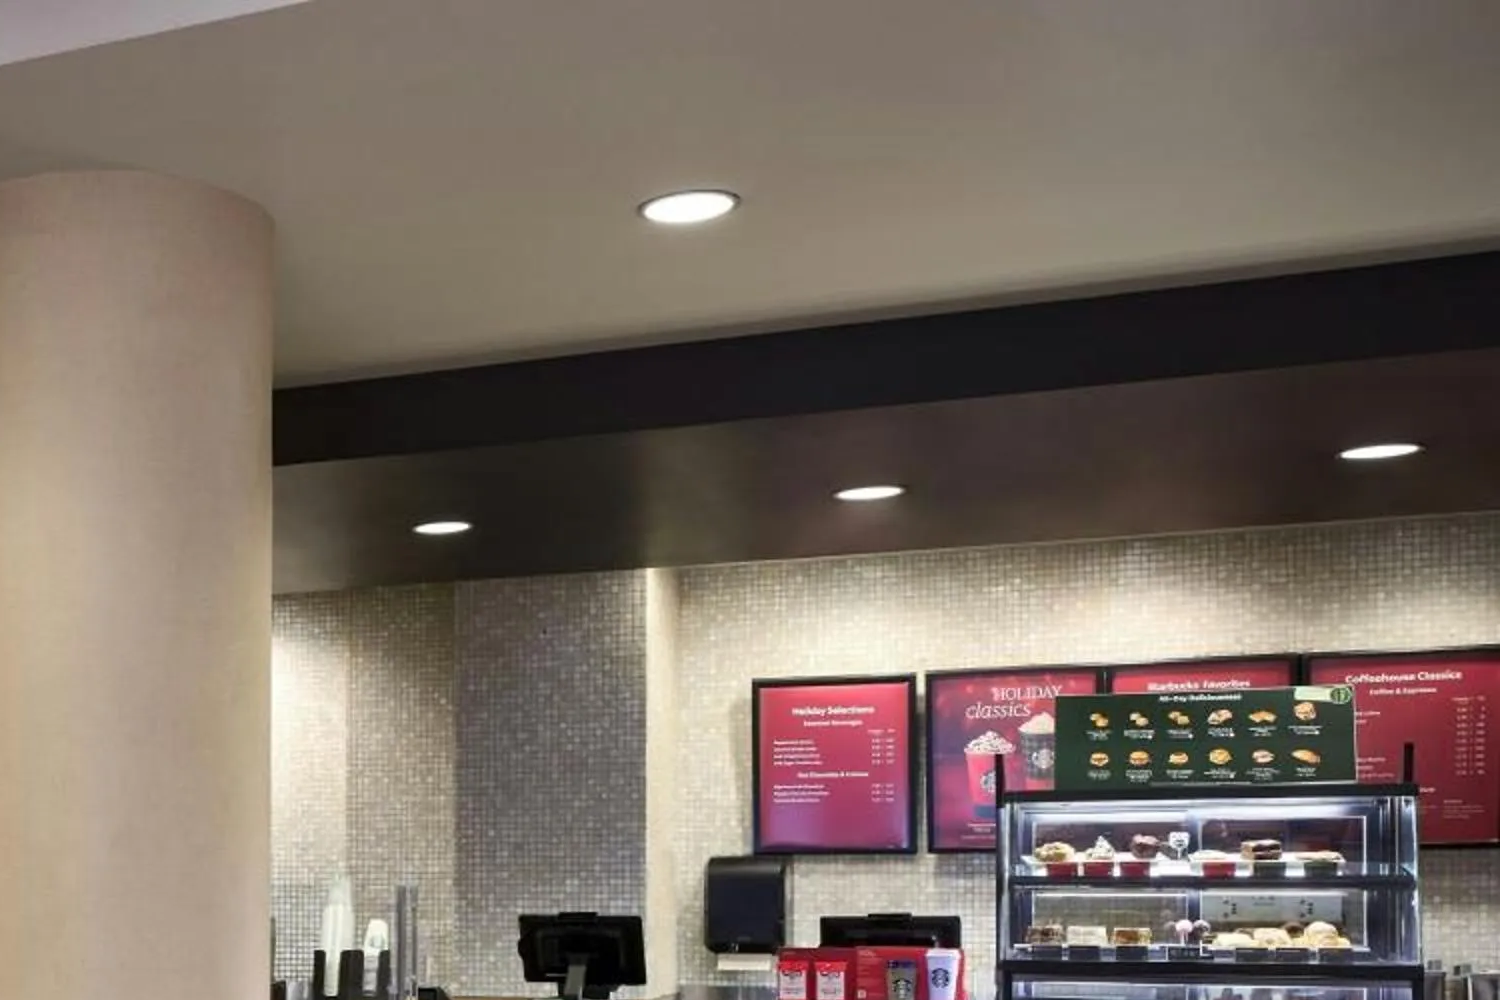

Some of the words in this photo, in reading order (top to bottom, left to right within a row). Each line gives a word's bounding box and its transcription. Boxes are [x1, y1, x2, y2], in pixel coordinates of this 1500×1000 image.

[1202, 679, 1251, 689] Favorites
[1345, 672, 1415, 685] Coffeehouse
[1417, 669, 1463, 681] Classics
[991, 684, 1063, 701] HOLIDAY
[792, 706, 826, 717] Holiday
[828, 705, 875, 715] Selections
[965, 701, 1032, 719] classics
